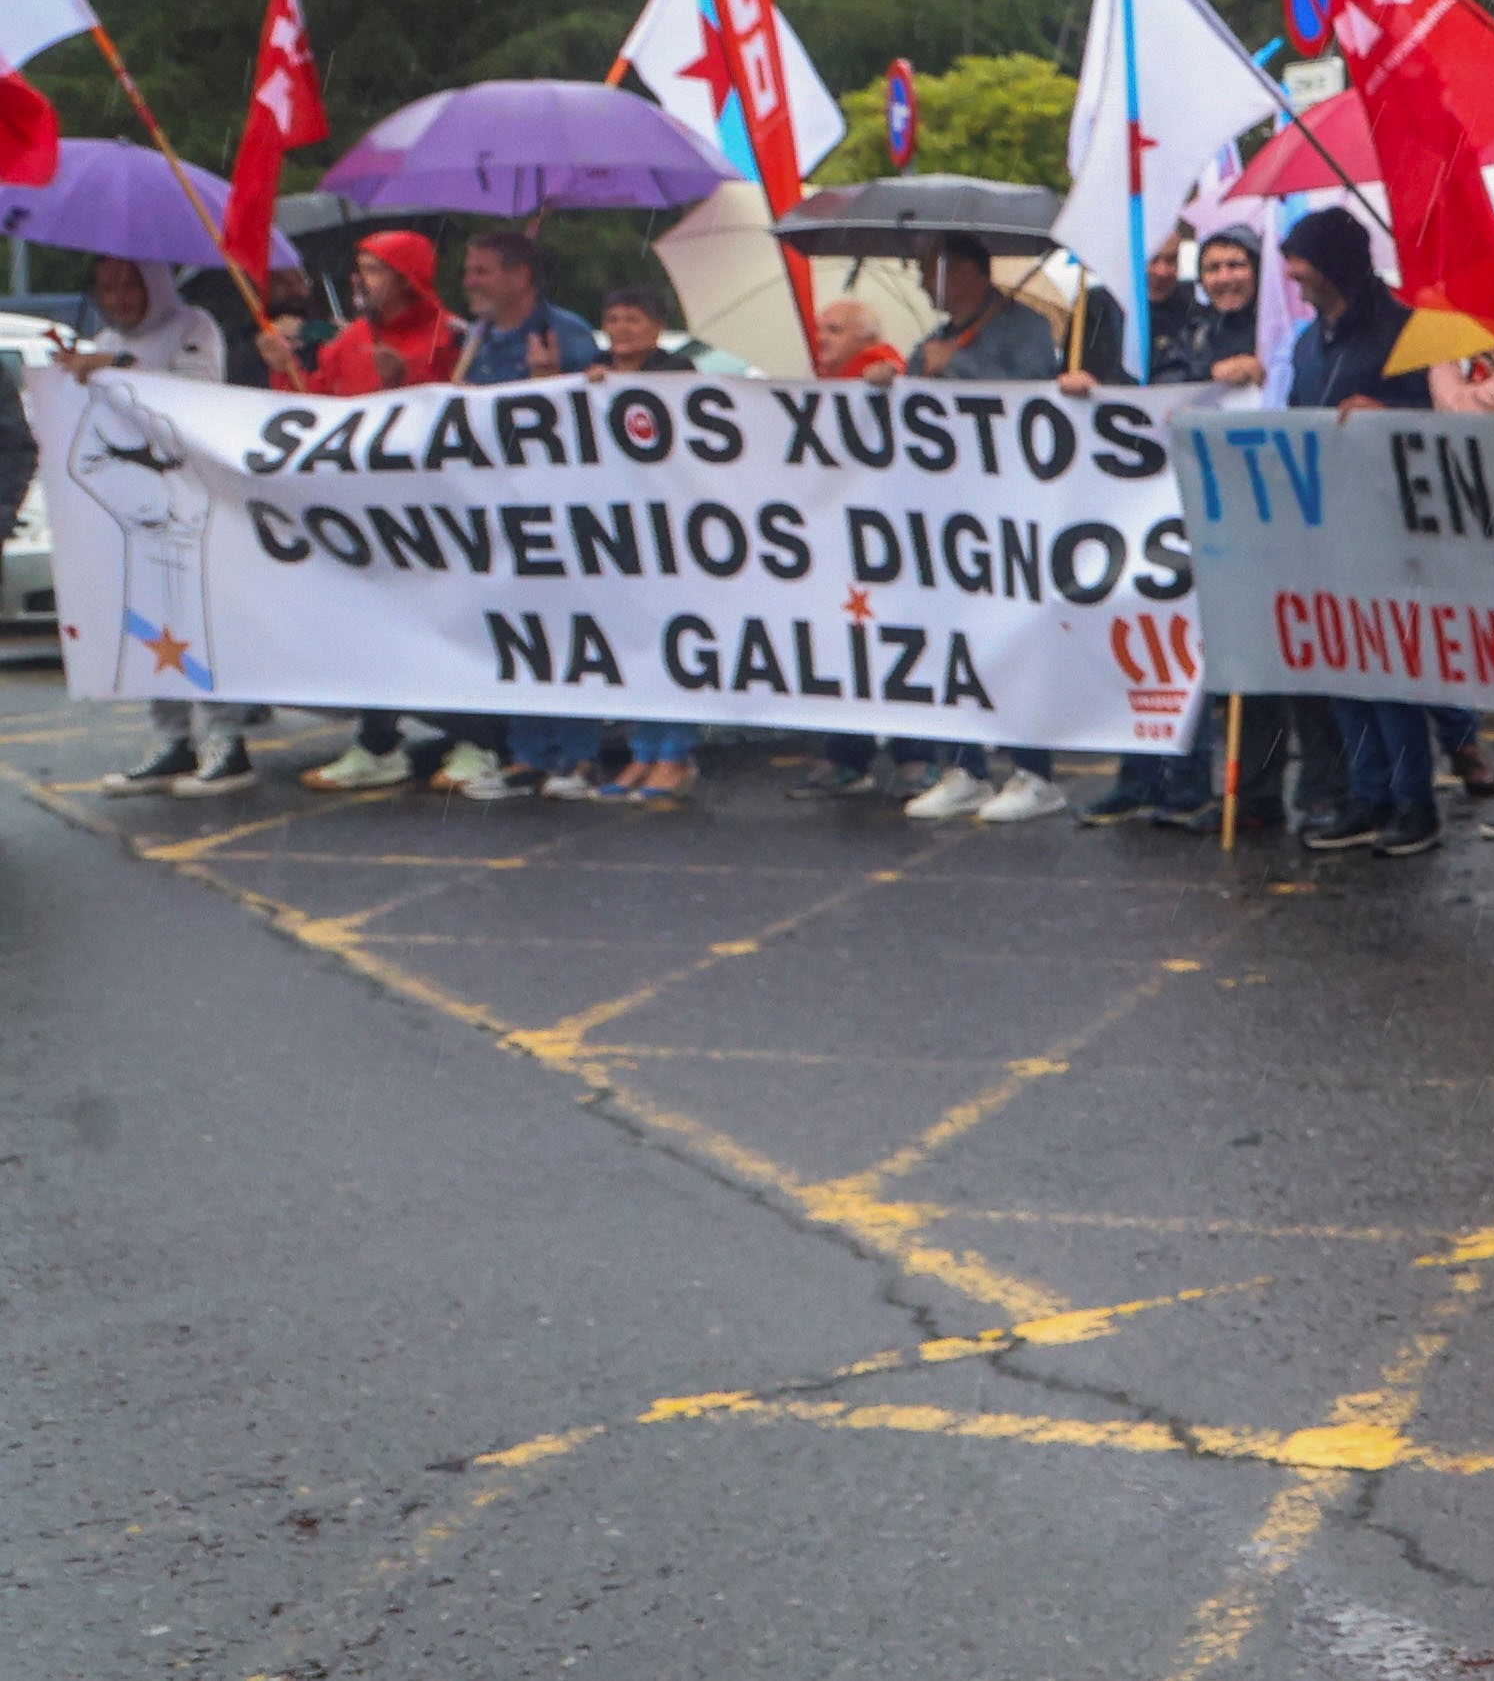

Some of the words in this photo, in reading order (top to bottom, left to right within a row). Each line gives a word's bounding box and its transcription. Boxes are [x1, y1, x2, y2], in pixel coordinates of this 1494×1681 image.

[244, 386, 744, 477] SALARIOS
[771, 388, 1168, 482] XUSTOS
[1191, 428, 1321, 526] ITV
[246, 499, 812, 584] CONVENIOS
[850, 506, 1197, 607] DIGNOS
[485, 609, 623, 692] NA
[663, 611, 995, 711] GALIZA
